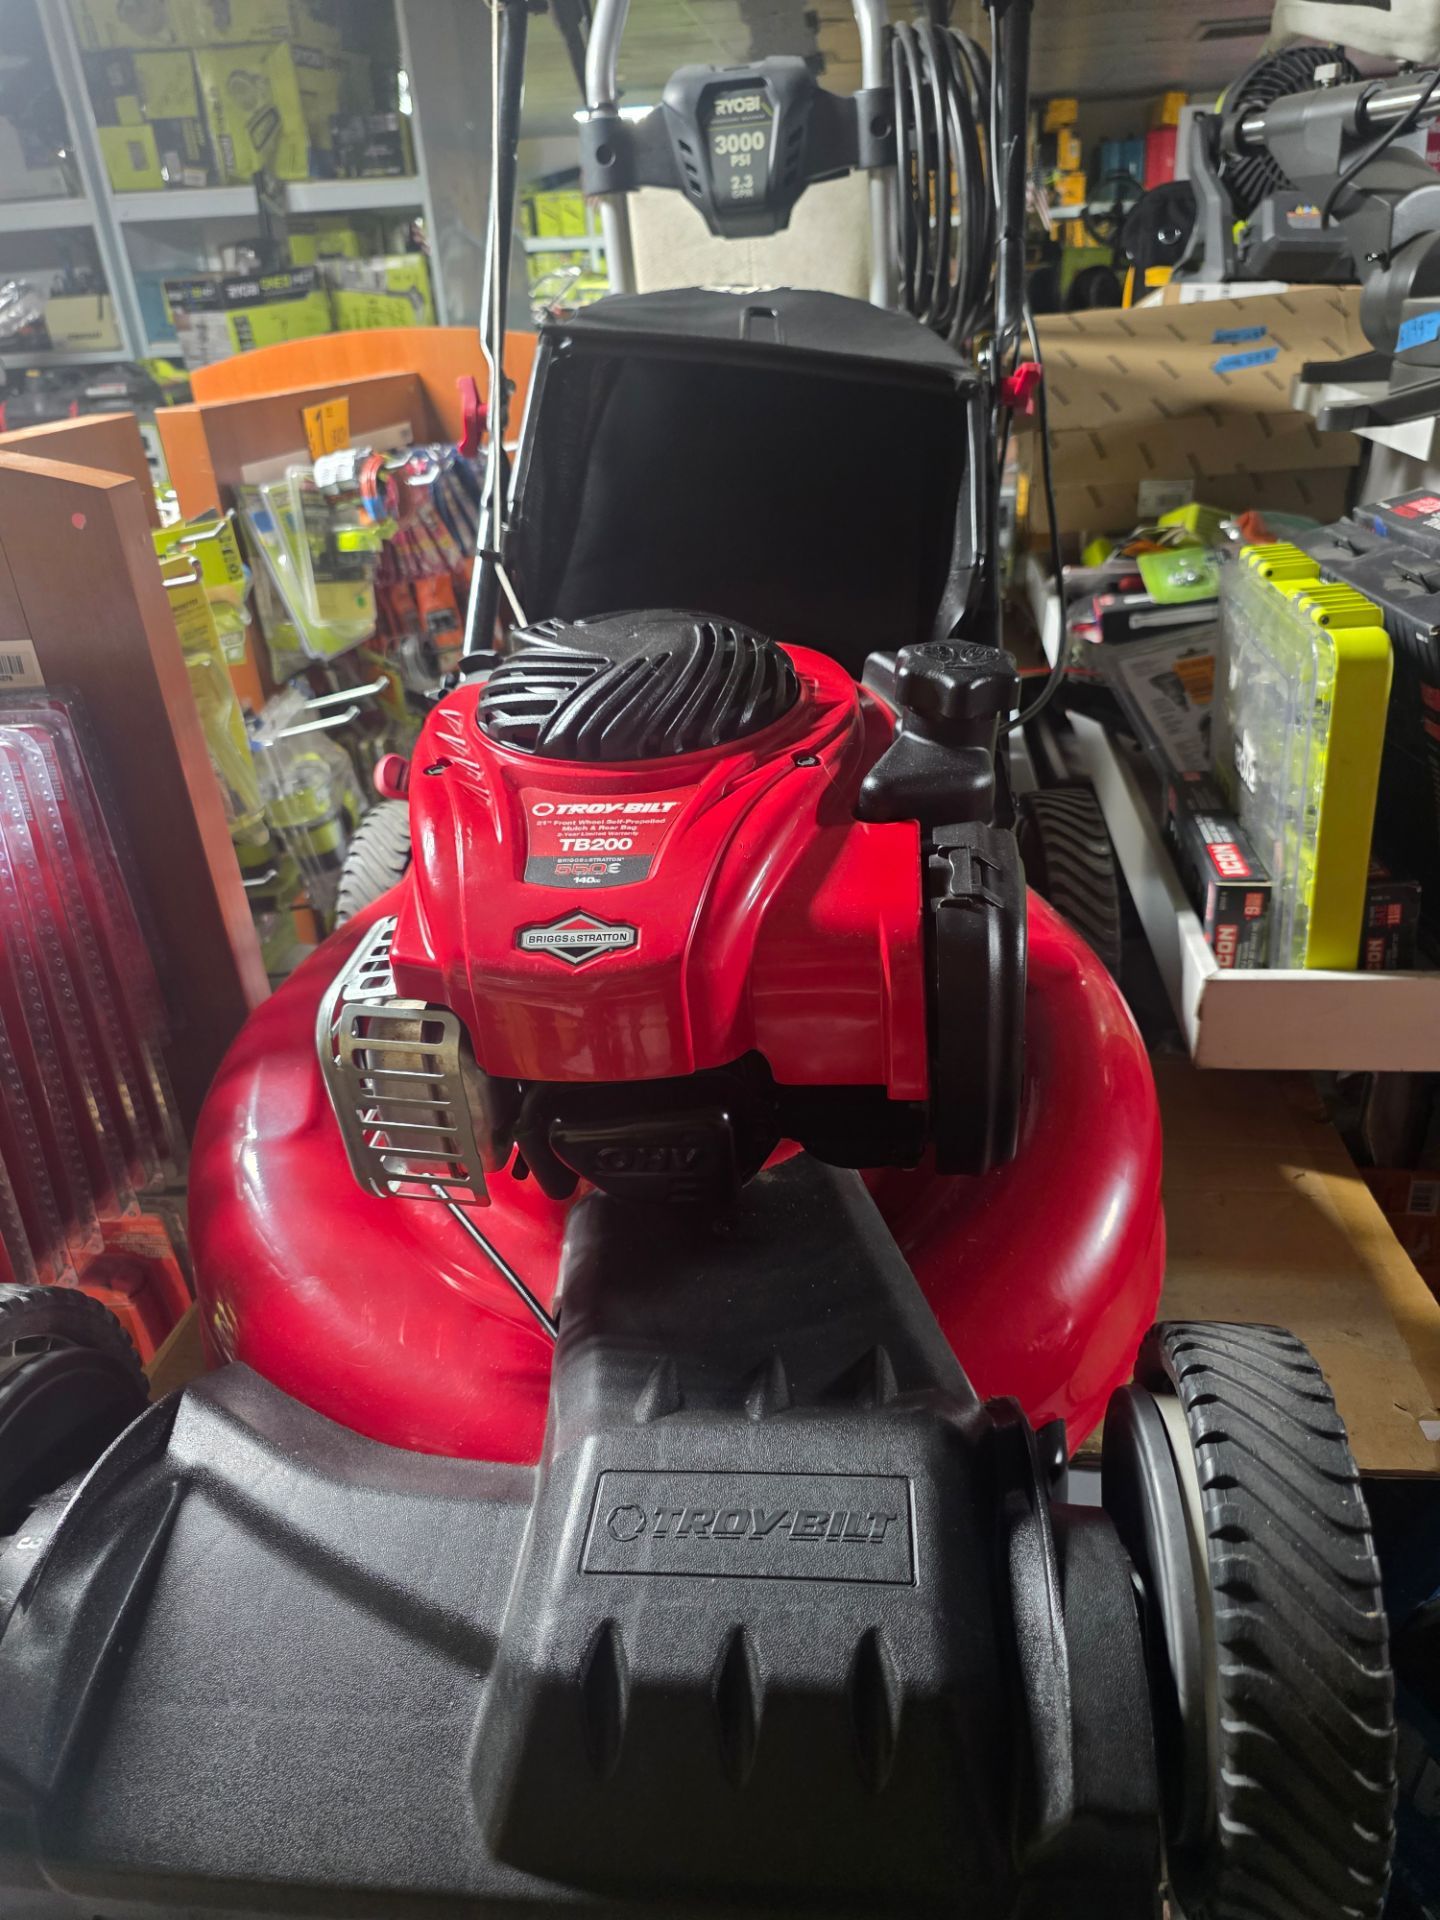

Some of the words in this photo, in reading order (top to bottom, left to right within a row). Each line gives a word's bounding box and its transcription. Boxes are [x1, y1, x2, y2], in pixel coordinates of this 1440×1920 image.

[714, 95, 761, 115] RYOBI
[715, 131, 765, 155] 3000
[730, 153, 751, 168] PSI
[730, 174, 753, 190] 2.3
[556, 801, 677, 815] TROY-BILT
[606, 818, 666, 826] Self-Propelled
[560, 837, 633, 851] TB200
[1211, 845, 1246, 876] ICON
[528, 932, 627, 944] BRIGGS&STRATTON
[1217, 927, 1235, 967] CON
[653, 1505, 898, 1543] TROY-BILT
